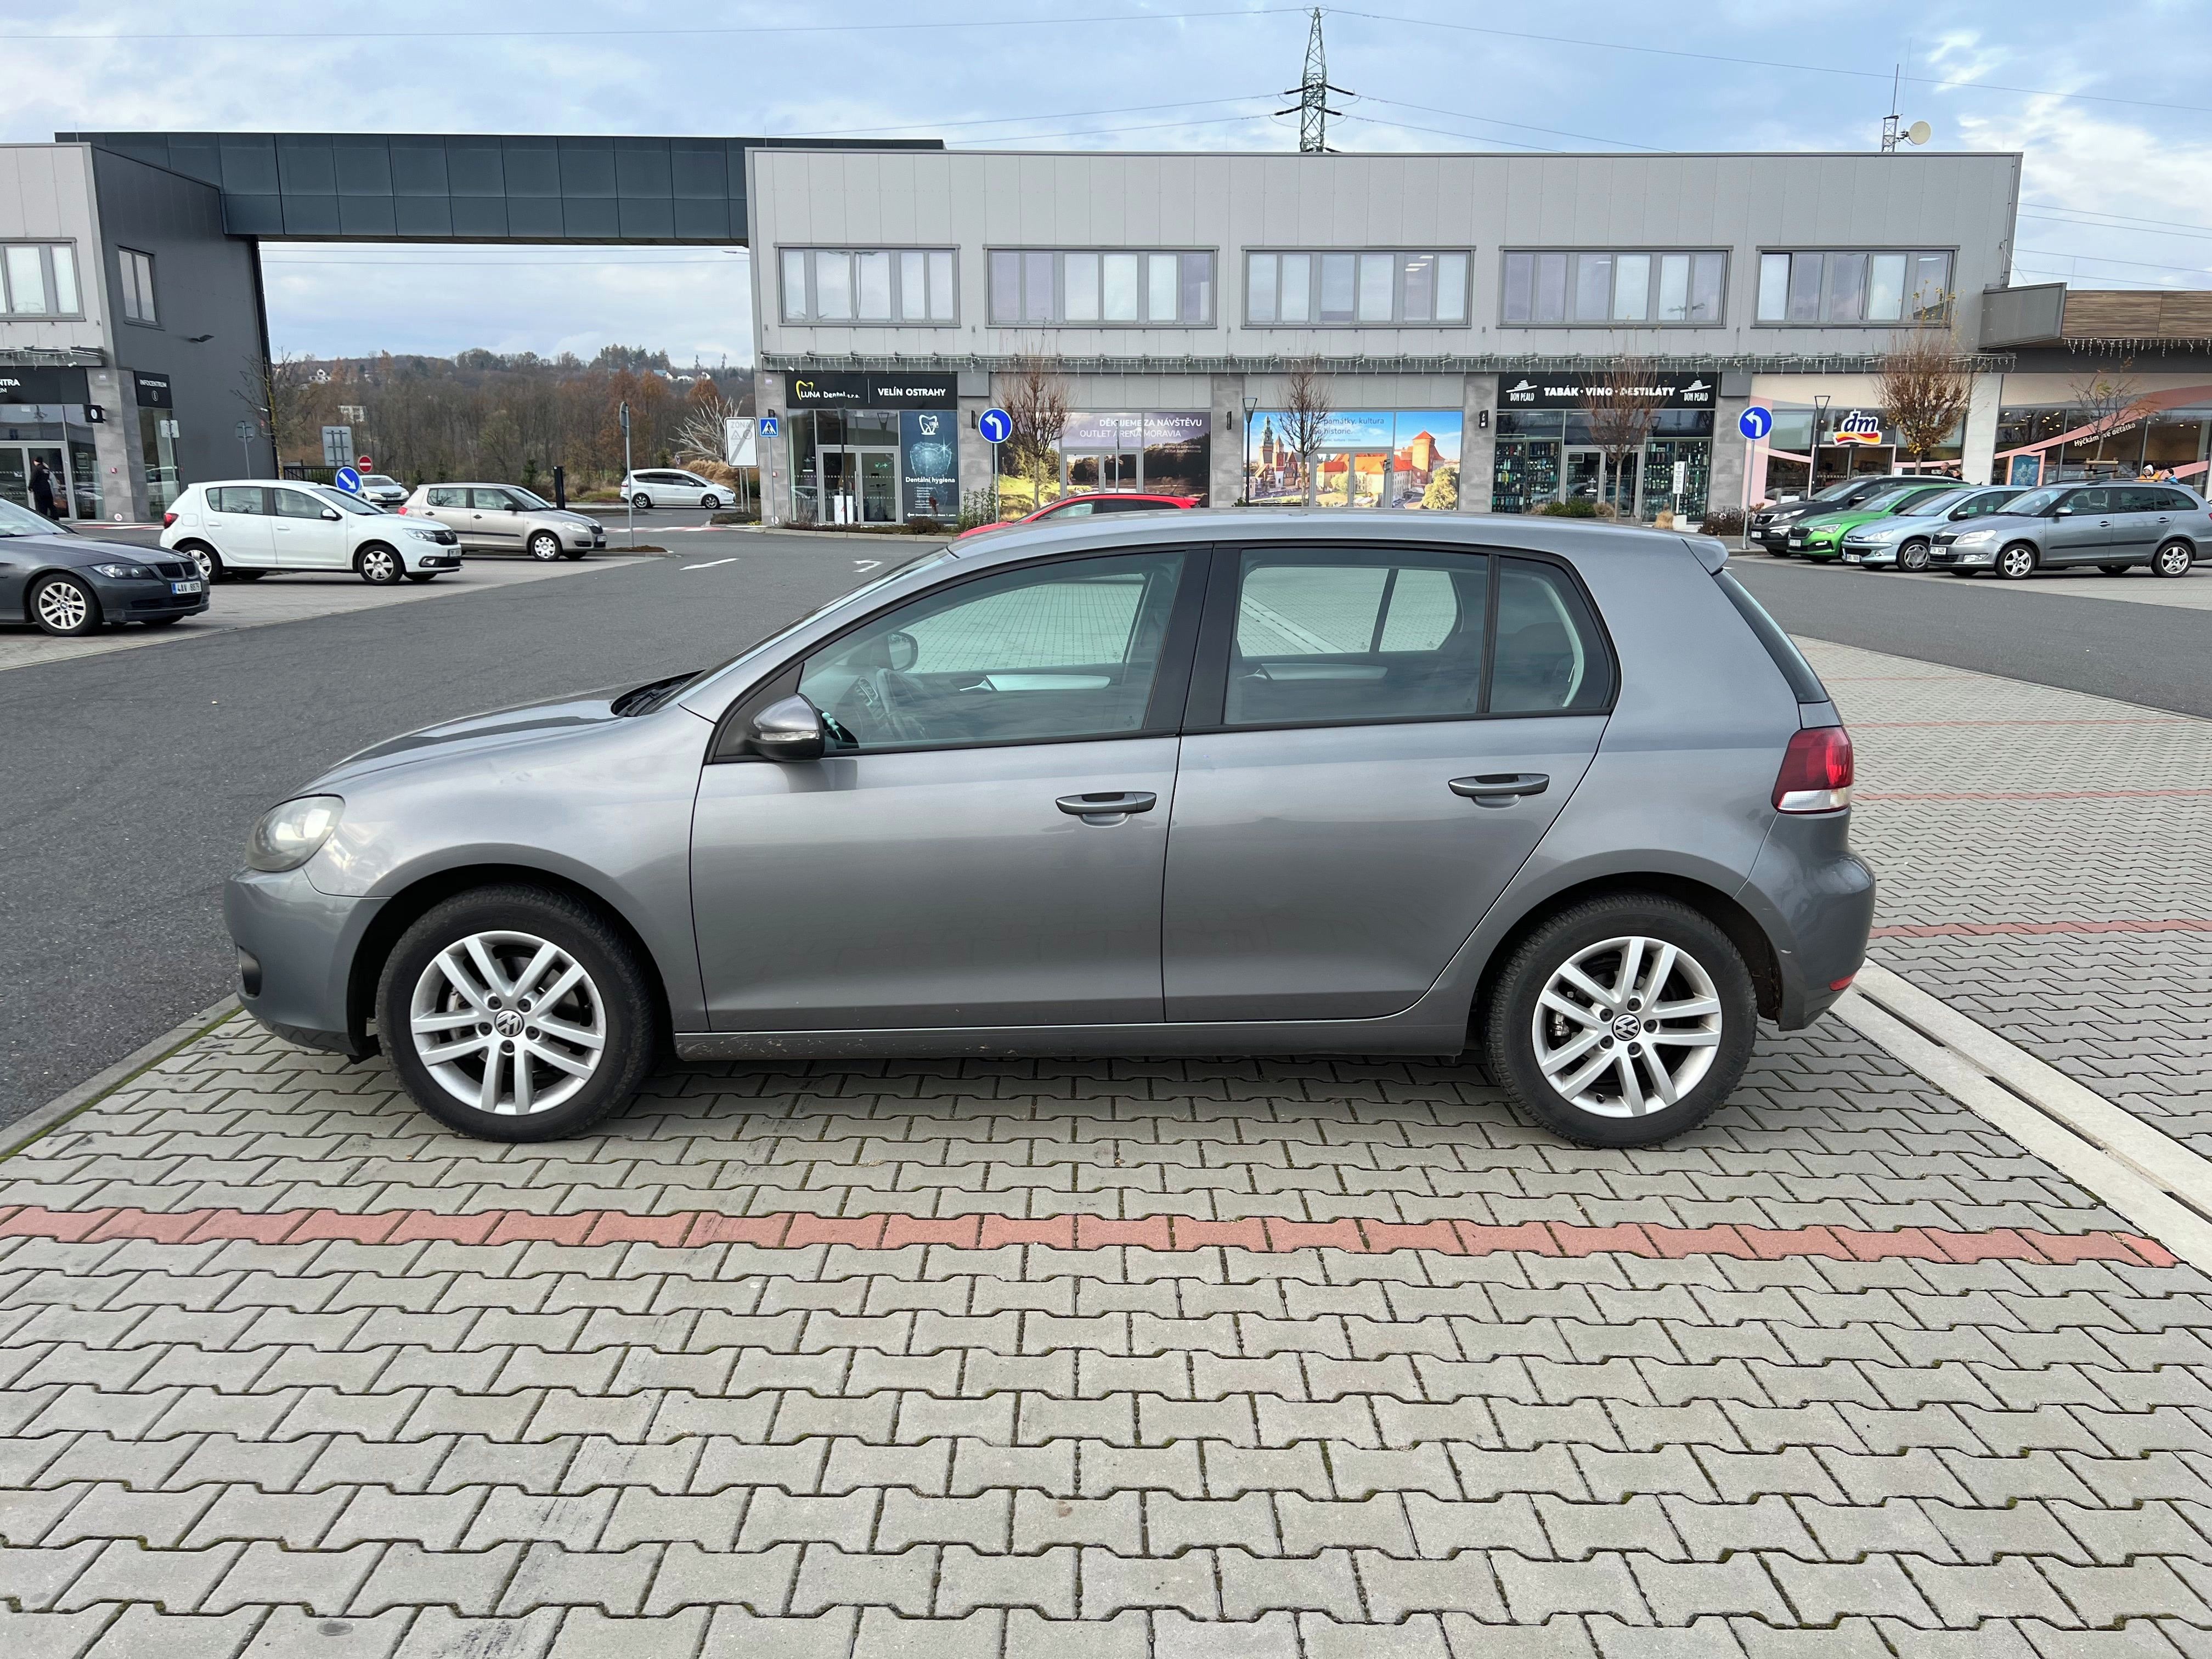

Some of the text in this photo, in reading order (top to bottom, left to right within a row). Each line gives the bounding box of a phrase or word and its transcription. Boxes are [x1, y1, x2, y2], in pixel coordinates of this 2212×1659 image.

[877, 386, 946, 396] VELÍN OSTRAHY
[1544, 385, 1675, 396] TABÁK VÍNO DESTILÁTY
[1510, 393, 1534, 401] DON PEALO
[1684, 392, 1708, 401] DON PEALO
[1157, 417, 1202, 427] NÁVŠTĚVU
[1844, 413, 1876, 432] dm
[1080, 430, 1111, 438] OUTLET
[1144, 430, 1181, 438] MORAVIA
[2074, 435, 2100, 447] Hýčkám
[932, 476, 956, 484] hygiena
